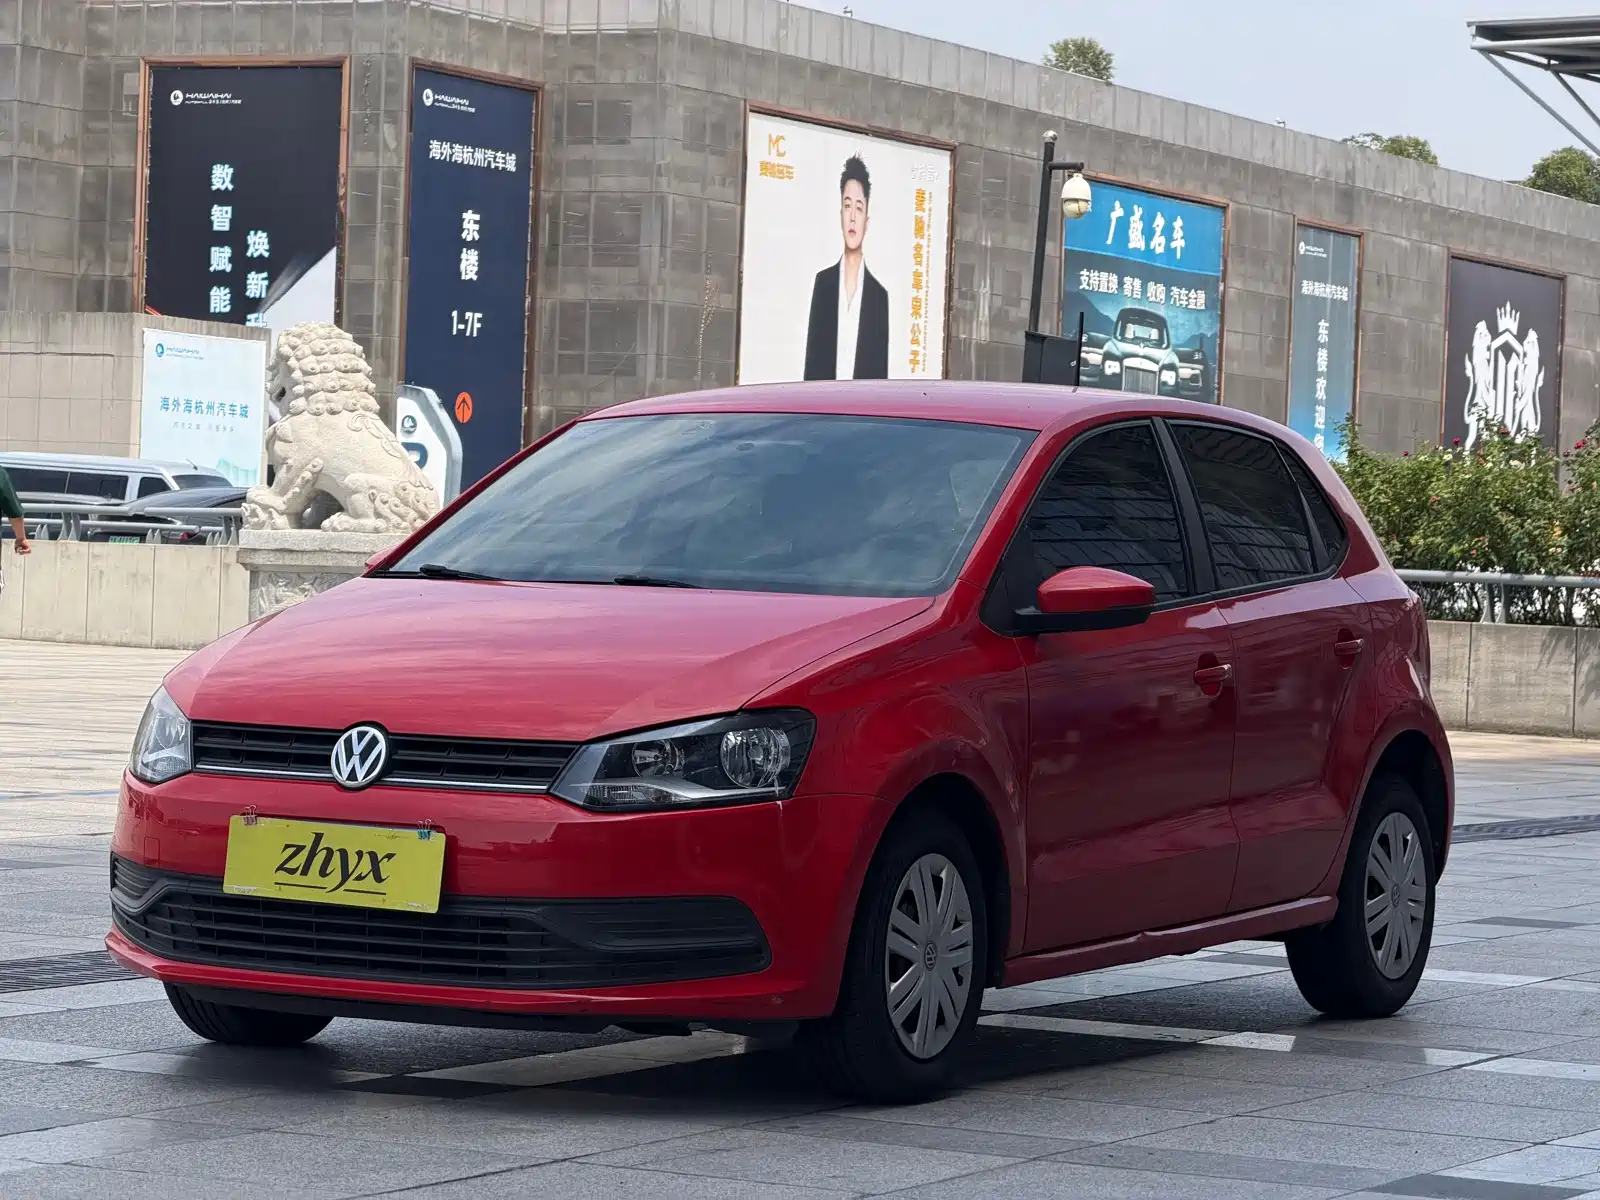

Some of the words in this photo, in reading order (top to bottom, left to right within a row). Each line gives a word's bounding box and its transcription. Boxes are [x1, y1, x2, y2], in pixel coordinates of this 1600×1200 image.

[429, 139, 517, 173] 海外海杭州汽车城
[209, 163, 234, 314] 数智赋能
[459, 209, 481, 282] 东楼
[1079, 268, 1119, 295] 支持置换
[1122, 275, 1143, 299] 寄售
[1146, 281, 1167, 304] 收购
[1170, 286, 1206, 310] 汽车金融
[450, 309, 483, 338] 1-7F
[159, 395, 250, 420] 海外海杭州汽车城
[274, 831, 397, 893] zhyx
